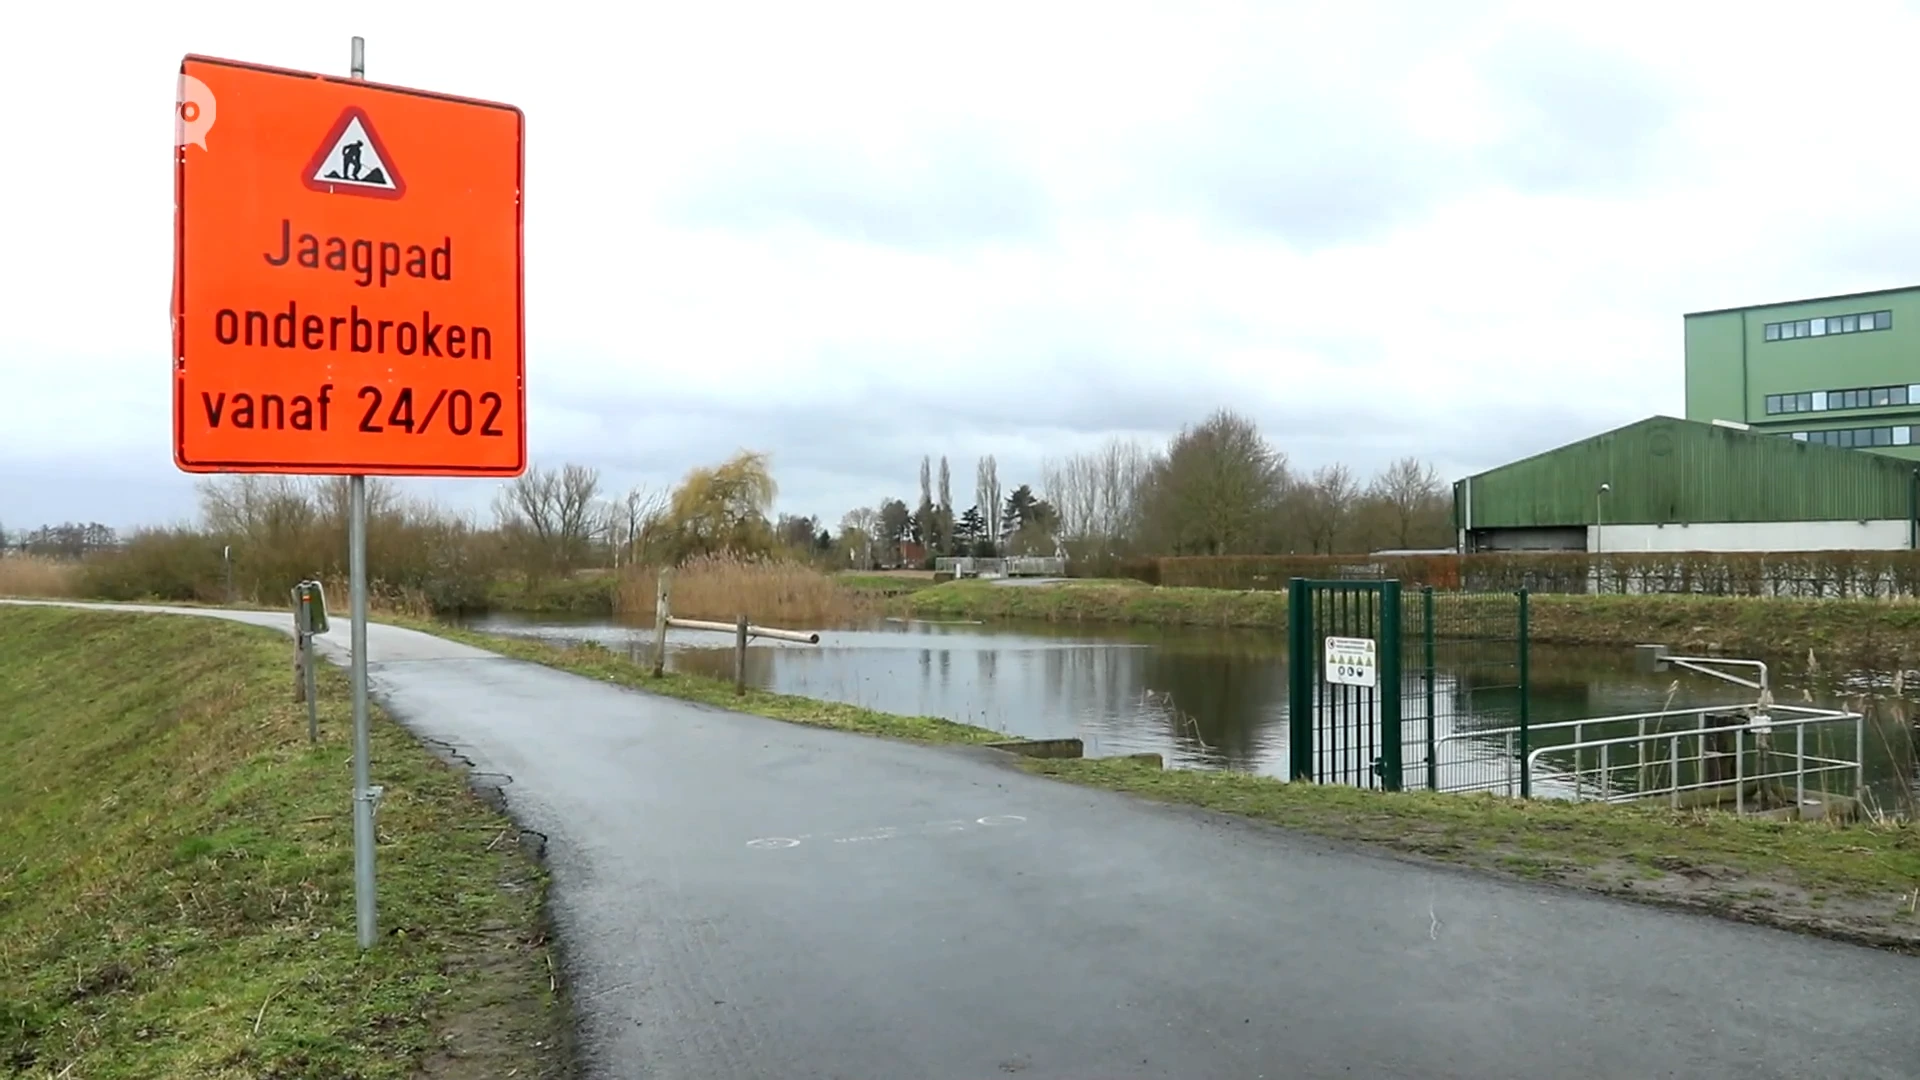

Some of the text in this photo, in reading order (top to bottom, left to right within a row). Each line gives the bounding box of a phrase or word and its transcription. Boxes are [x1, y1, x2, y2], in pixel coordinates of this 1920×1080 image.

[263, 219, 452, 288] Jaagpad
[215, 300, 492, 360] onderbroken
[202, 384, 503, 437] vanaf 24/02
